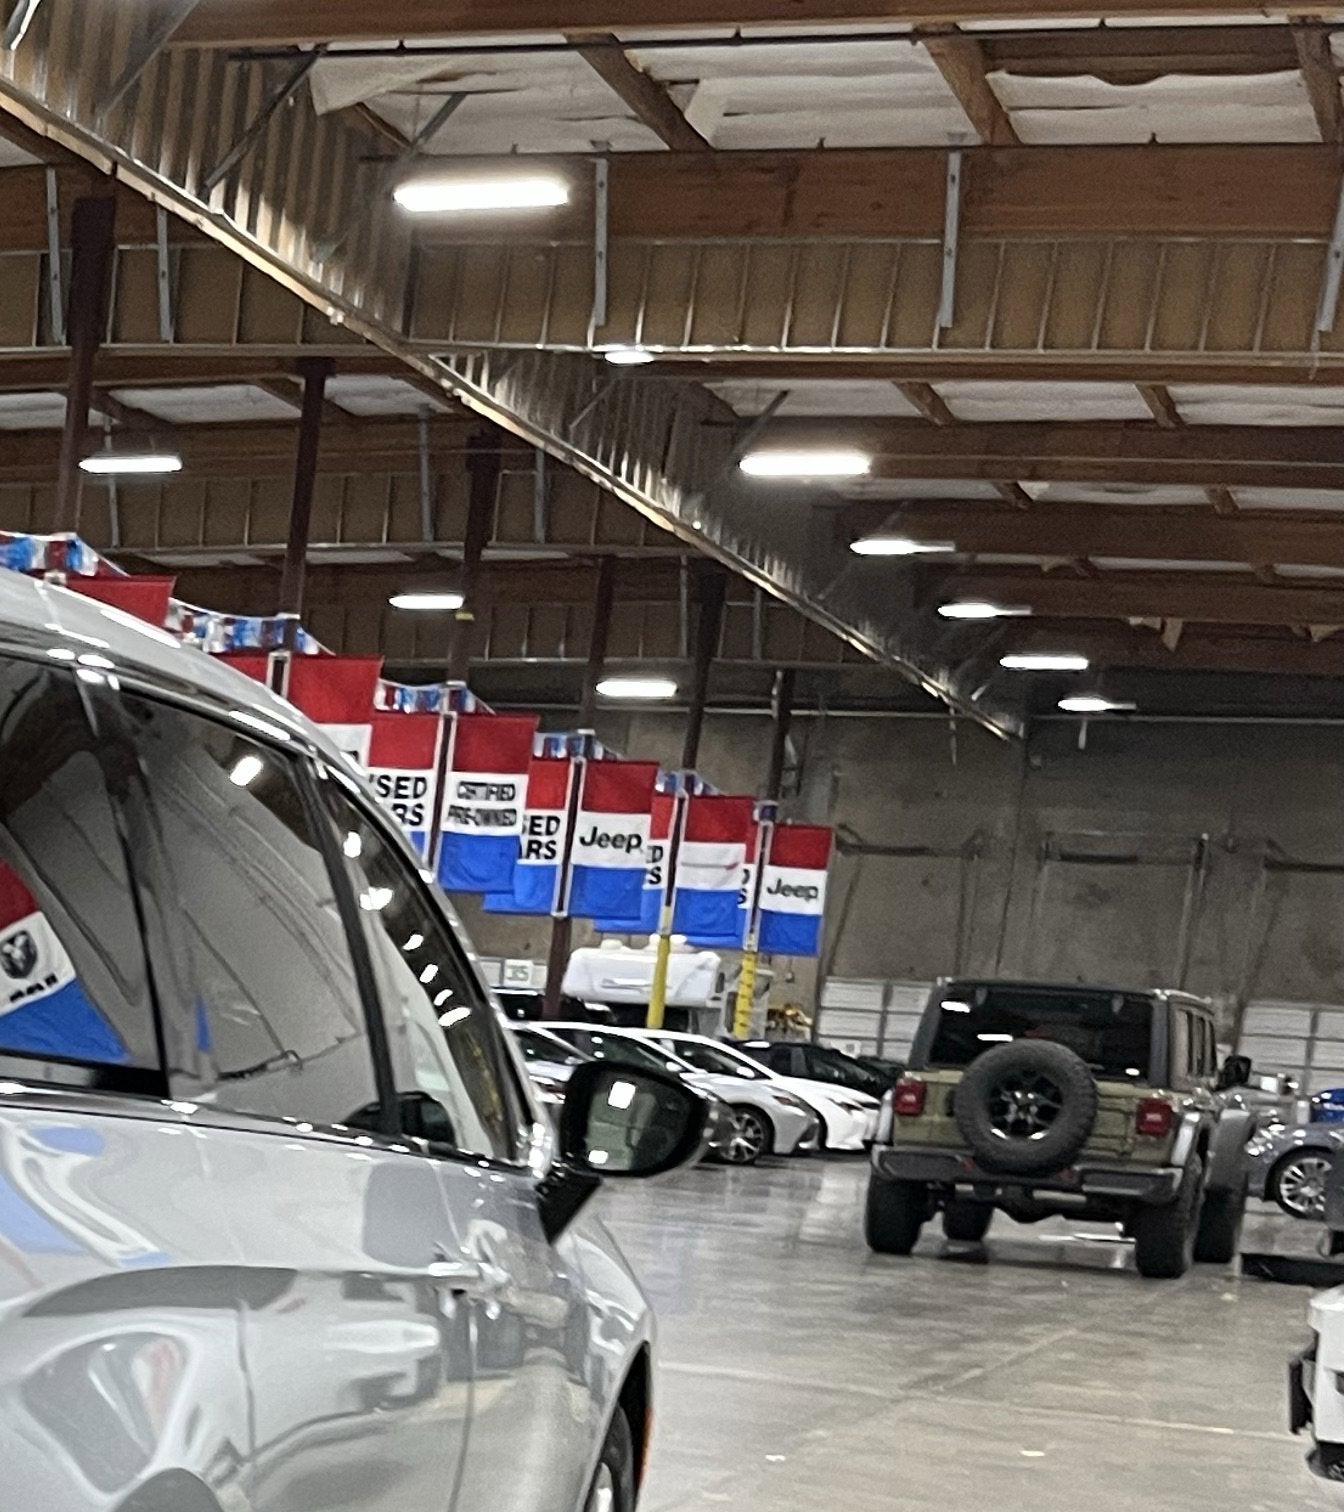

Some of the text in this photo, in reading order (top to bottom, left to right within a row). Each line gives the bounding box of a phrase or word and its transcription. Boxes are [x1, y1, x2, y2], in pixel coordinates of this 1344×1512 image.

[369, 773, 428, 799] SED
[391, 803, 425, 827] RS
[521, 814, 561, 837] ED
[520, 838, 557, 860] RS
[579, 826, 642, 854] Jeep
